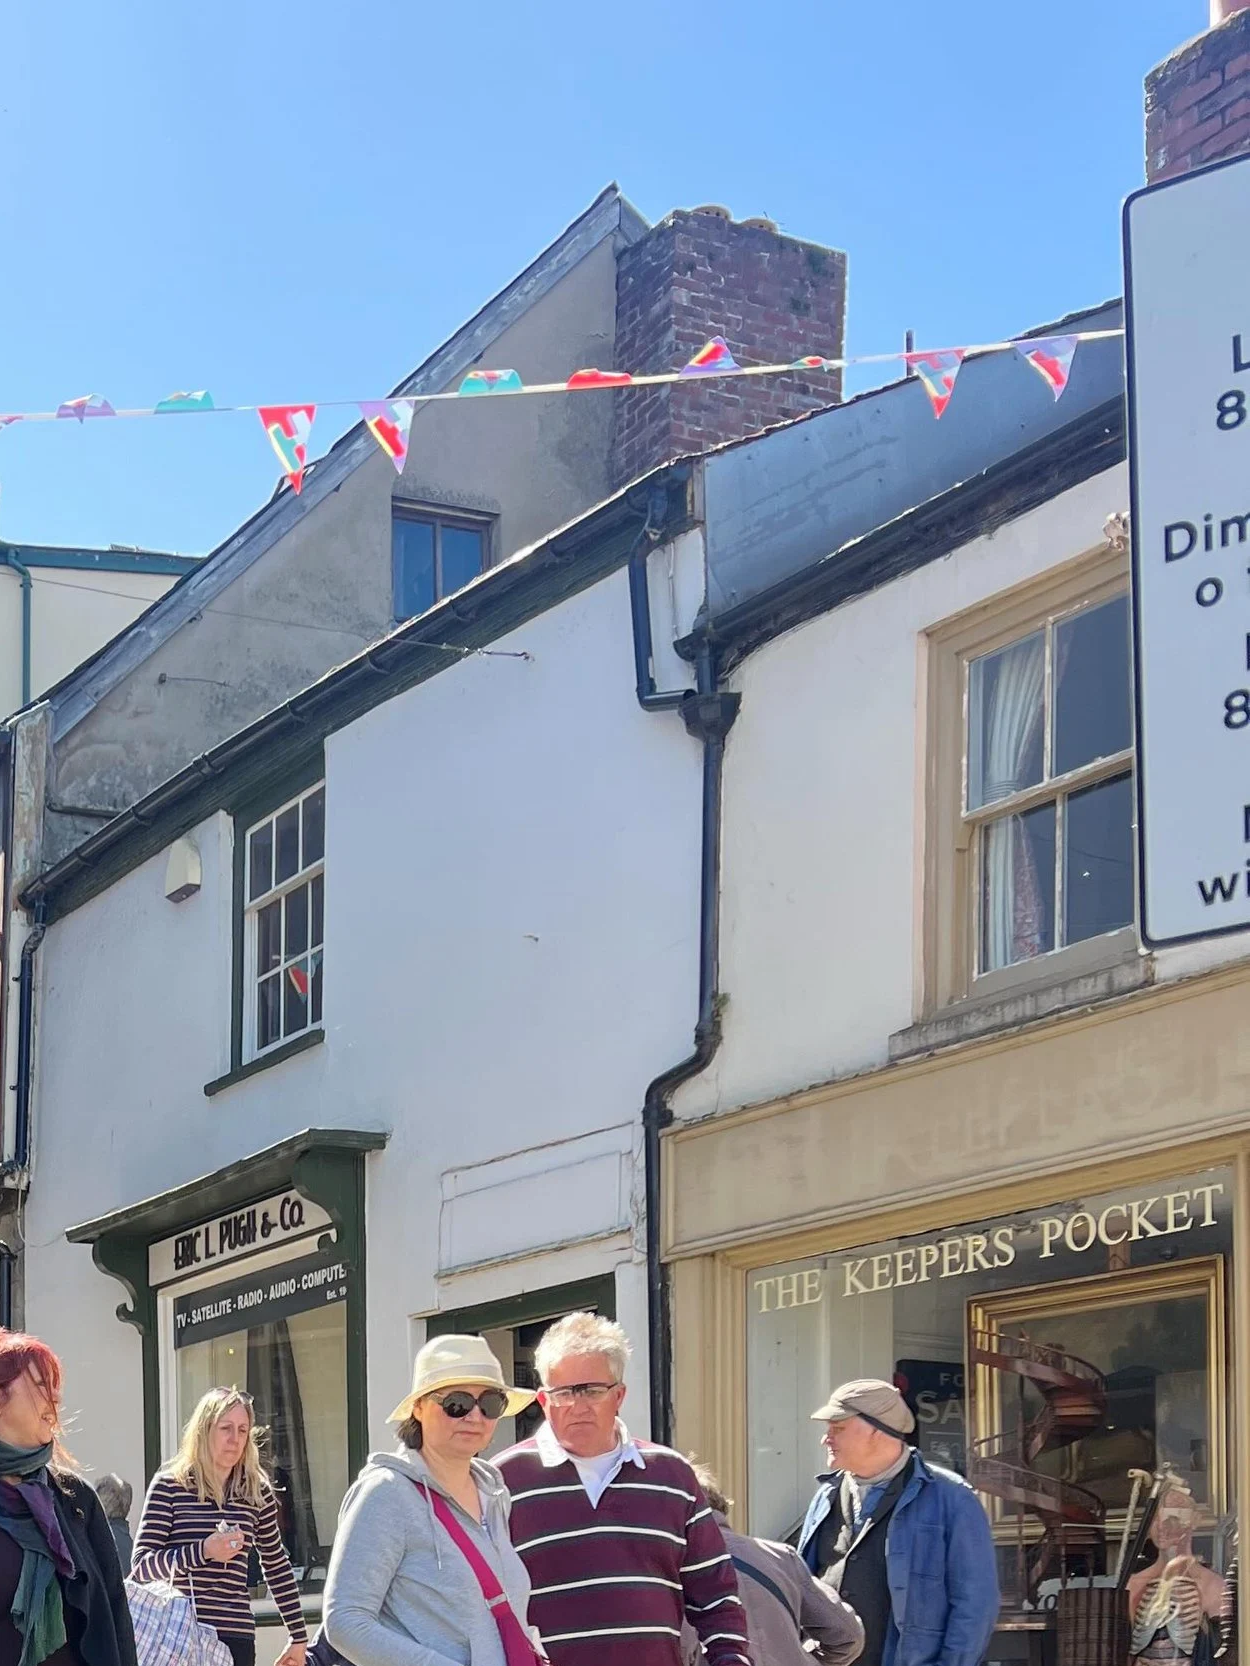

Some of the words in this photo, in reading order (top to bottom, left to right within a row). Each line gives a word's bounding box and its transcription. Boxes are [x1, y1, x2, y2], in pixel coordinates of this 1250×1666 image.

[1217, 389, 1247, 431] 8
[174, 1231, 201, 1271] ERIC
[204, 1226, 216, 1260] L
[219, 1209, 257, 1255] PUGH
[260, 1211, 278, 1239] &
[753, 1268, 822, 1314] THE
[841, 1227, 1015, 1298] KEEPERS
[1038, 1184, 1224, 1260] POCKET
[176, 1312, 187, 1329] TV
[191, 1298, 232, 1325] SATELLITE
[237, 1288, 263, 1311] RADIO
[268, 1278, 296, 1301] AUDIO
